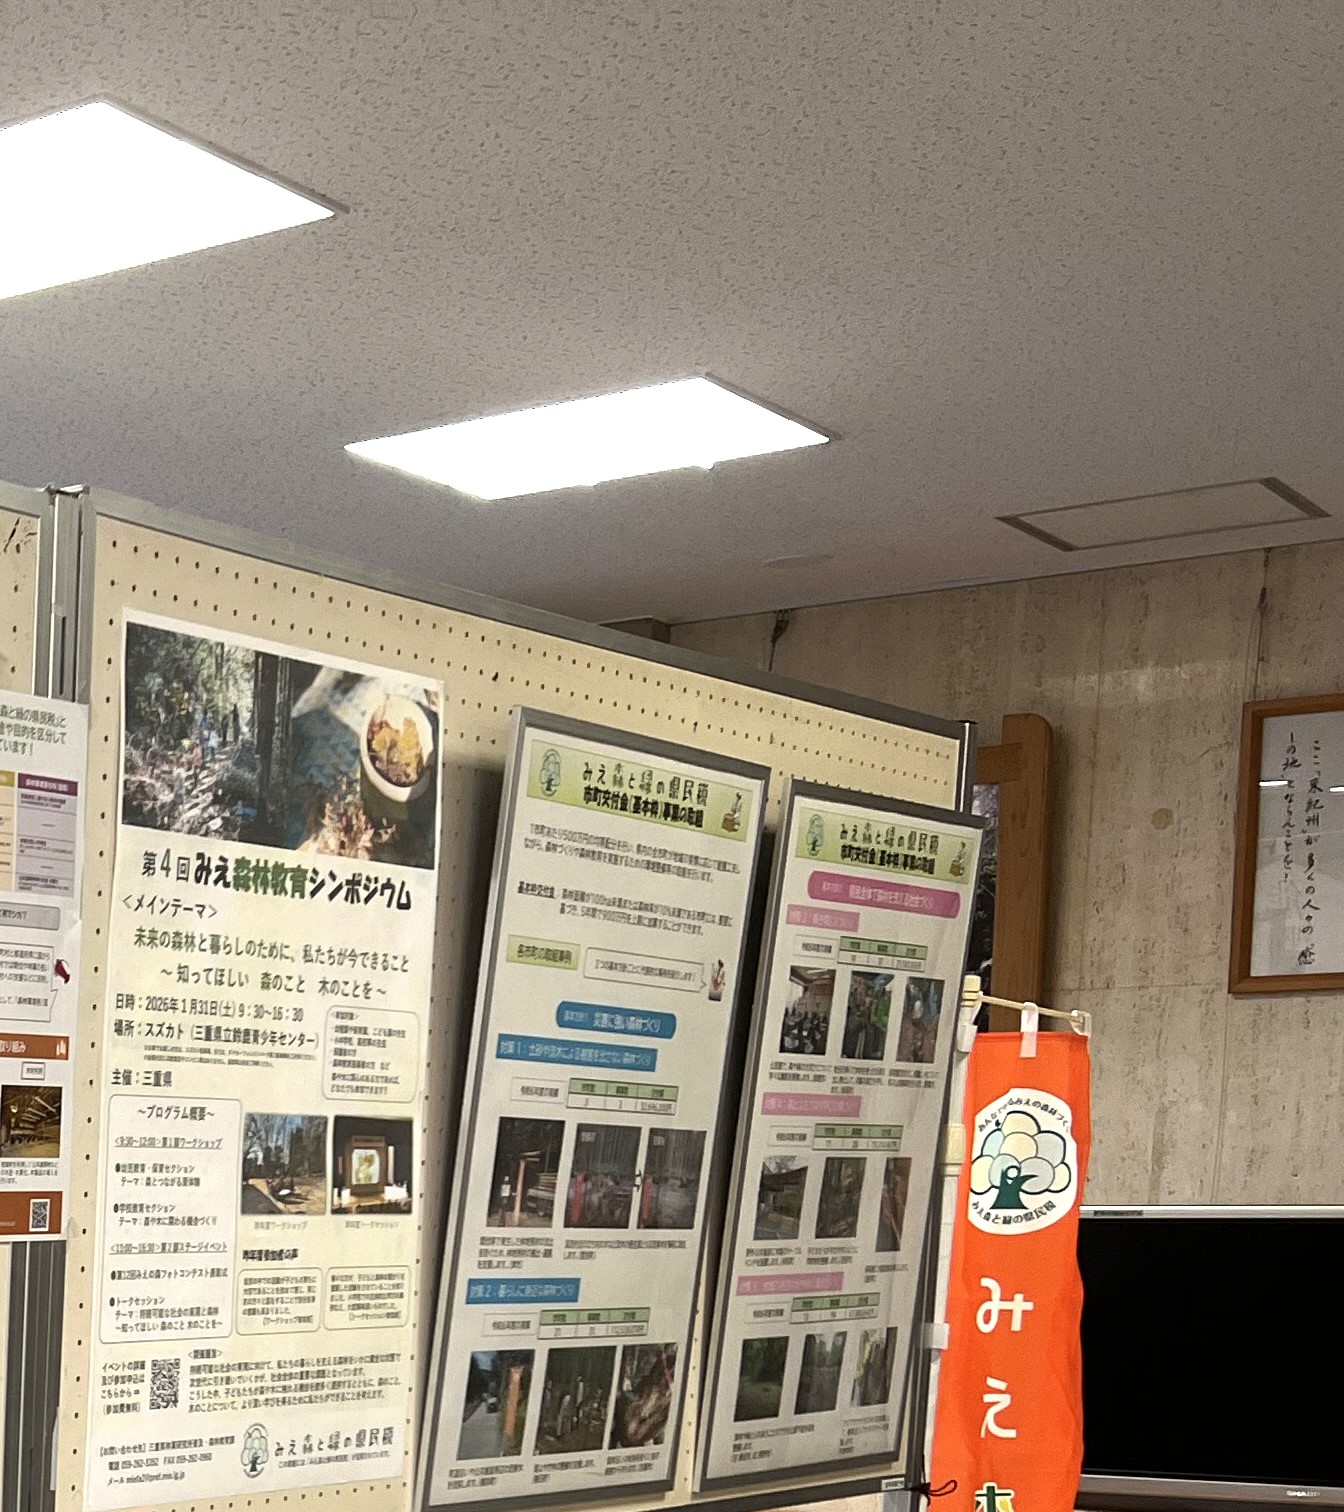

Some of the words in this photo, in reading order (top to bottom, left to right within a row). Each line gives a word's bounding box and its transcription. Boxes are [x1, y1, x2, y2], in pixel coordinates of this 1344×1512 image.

[142, 849, 411, 910] 第4回みえ森林教育シンポジウム
[134, 926, 409, 972] 未来の森林と暮らしのために、私たちが今できること
